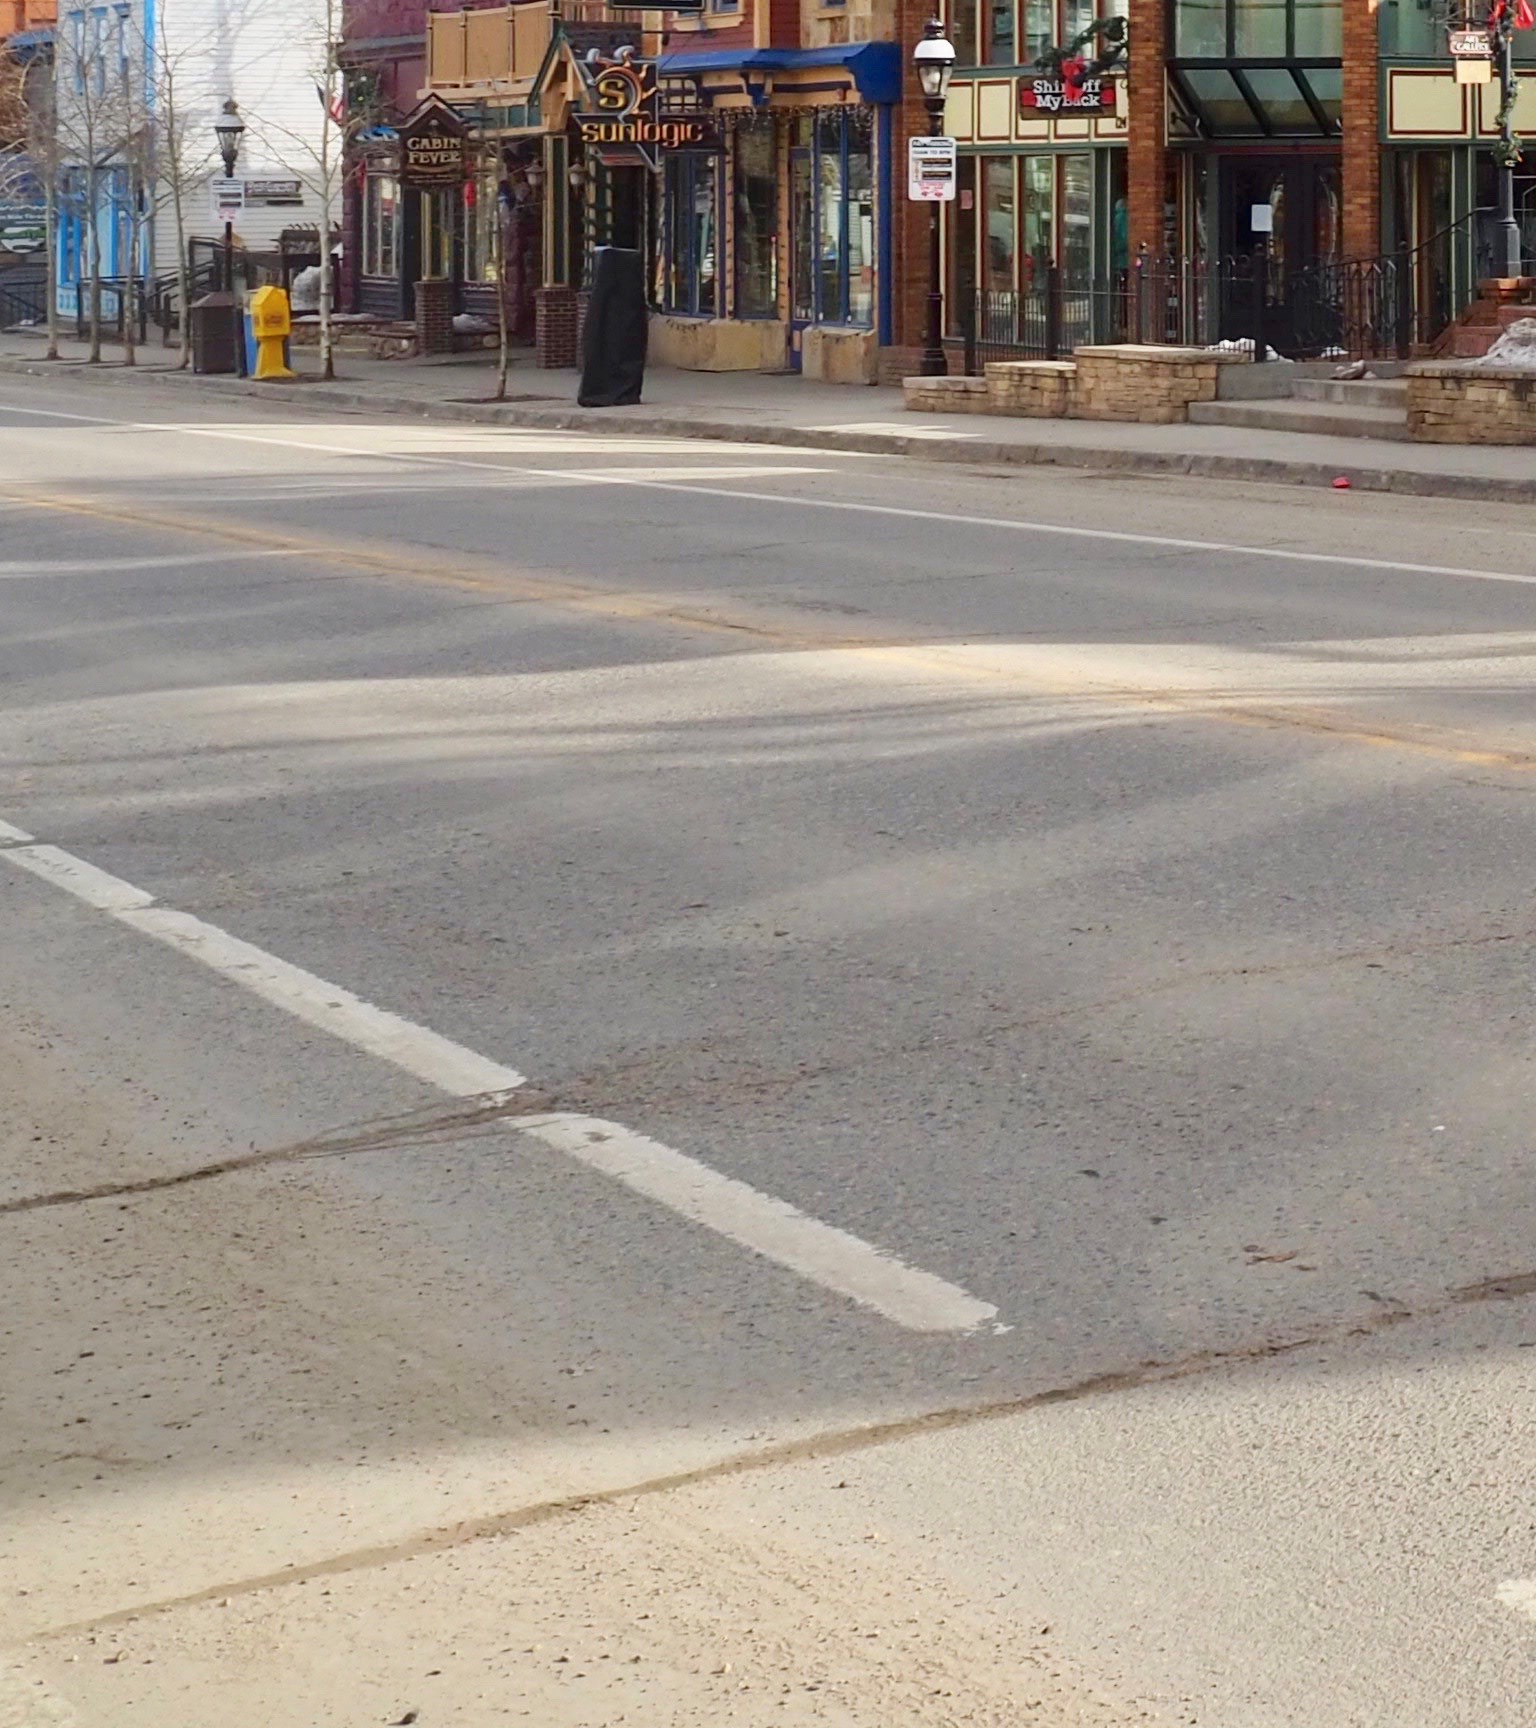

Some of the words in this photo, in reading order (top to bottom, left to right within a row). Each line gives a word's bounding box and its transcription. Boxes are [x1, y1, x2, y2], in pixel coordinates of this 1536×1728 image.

[1033, 79, 1068, 93] Shi
[1035, 95, 1061, 111] My
[581, 118, 704, 149] sunlogic
[407, 137, 462, 150] CABIN
[407, 151, 462, 165] FEVER
